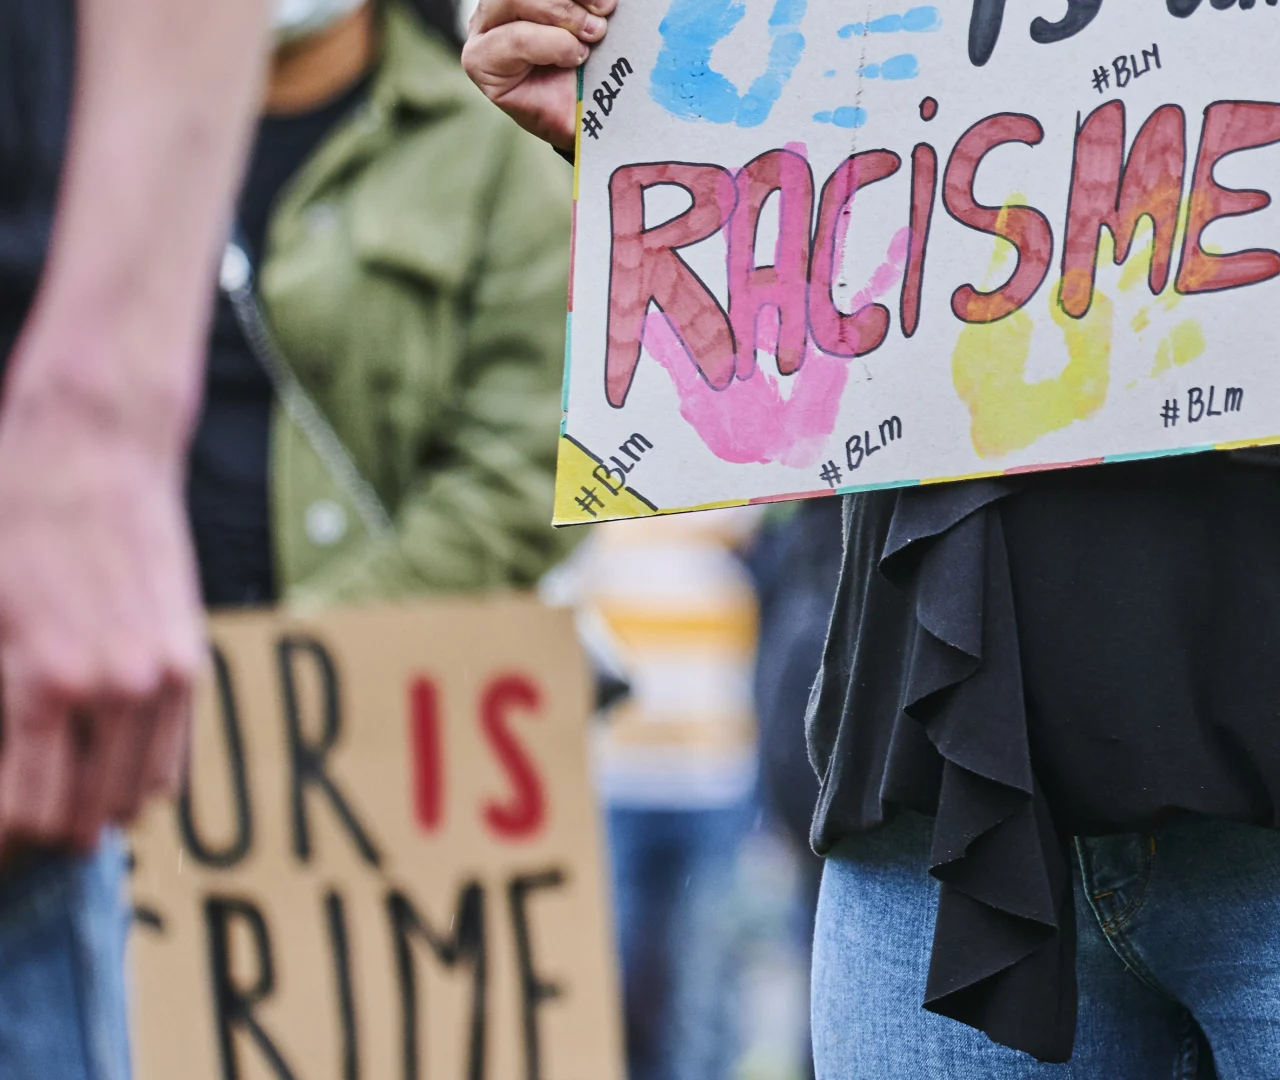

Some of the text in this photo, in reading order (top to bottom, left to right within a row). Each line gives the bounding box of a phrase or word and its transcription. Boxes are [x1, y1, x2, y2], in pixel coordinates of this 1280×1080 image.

[581, 57, 635, 140] #BLm
[1091, 43, 1162, 94] #BLM
[1159, 386, 1244, 427] #BLm
[574, 432, 654, 516] #BLm
[820, 415, 903, 488] #BLm
[405, 669, 551, 846] IS
[135, 864, 572, 1080] RIME
